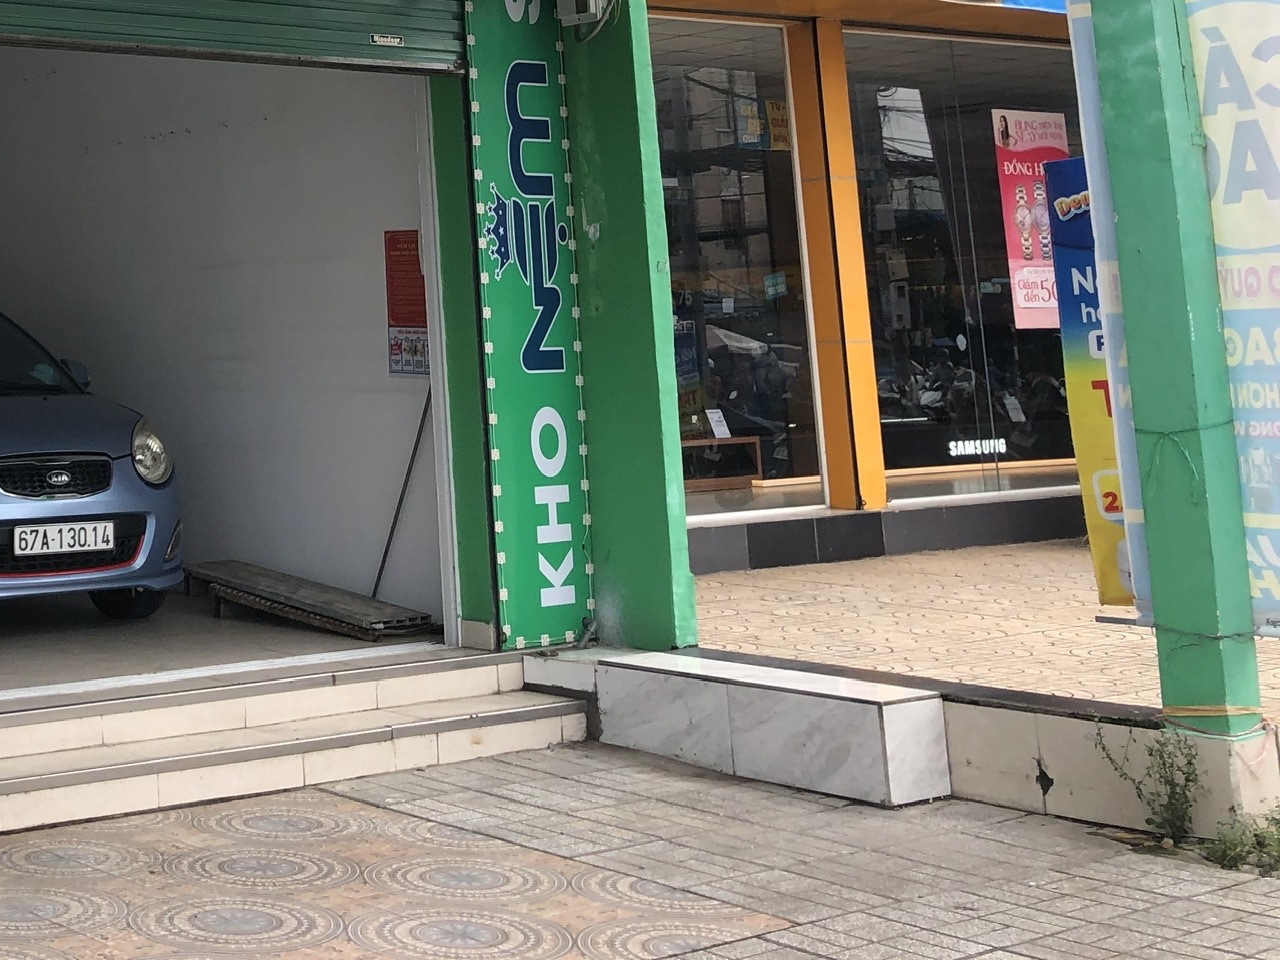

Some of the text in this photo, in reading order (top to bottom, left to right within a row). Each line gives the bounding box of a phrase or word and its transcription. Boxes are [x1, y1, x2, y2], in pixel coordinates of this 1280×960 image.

[1003, 159, 1033, 176] ĐỒNG
[948, 438, 1007, 456] SAMSUNG
[51, 474, 69, 482] KIA
[531, 407, 575, 607] KHO
[18, 525, 111, 552] 67A-130.14
